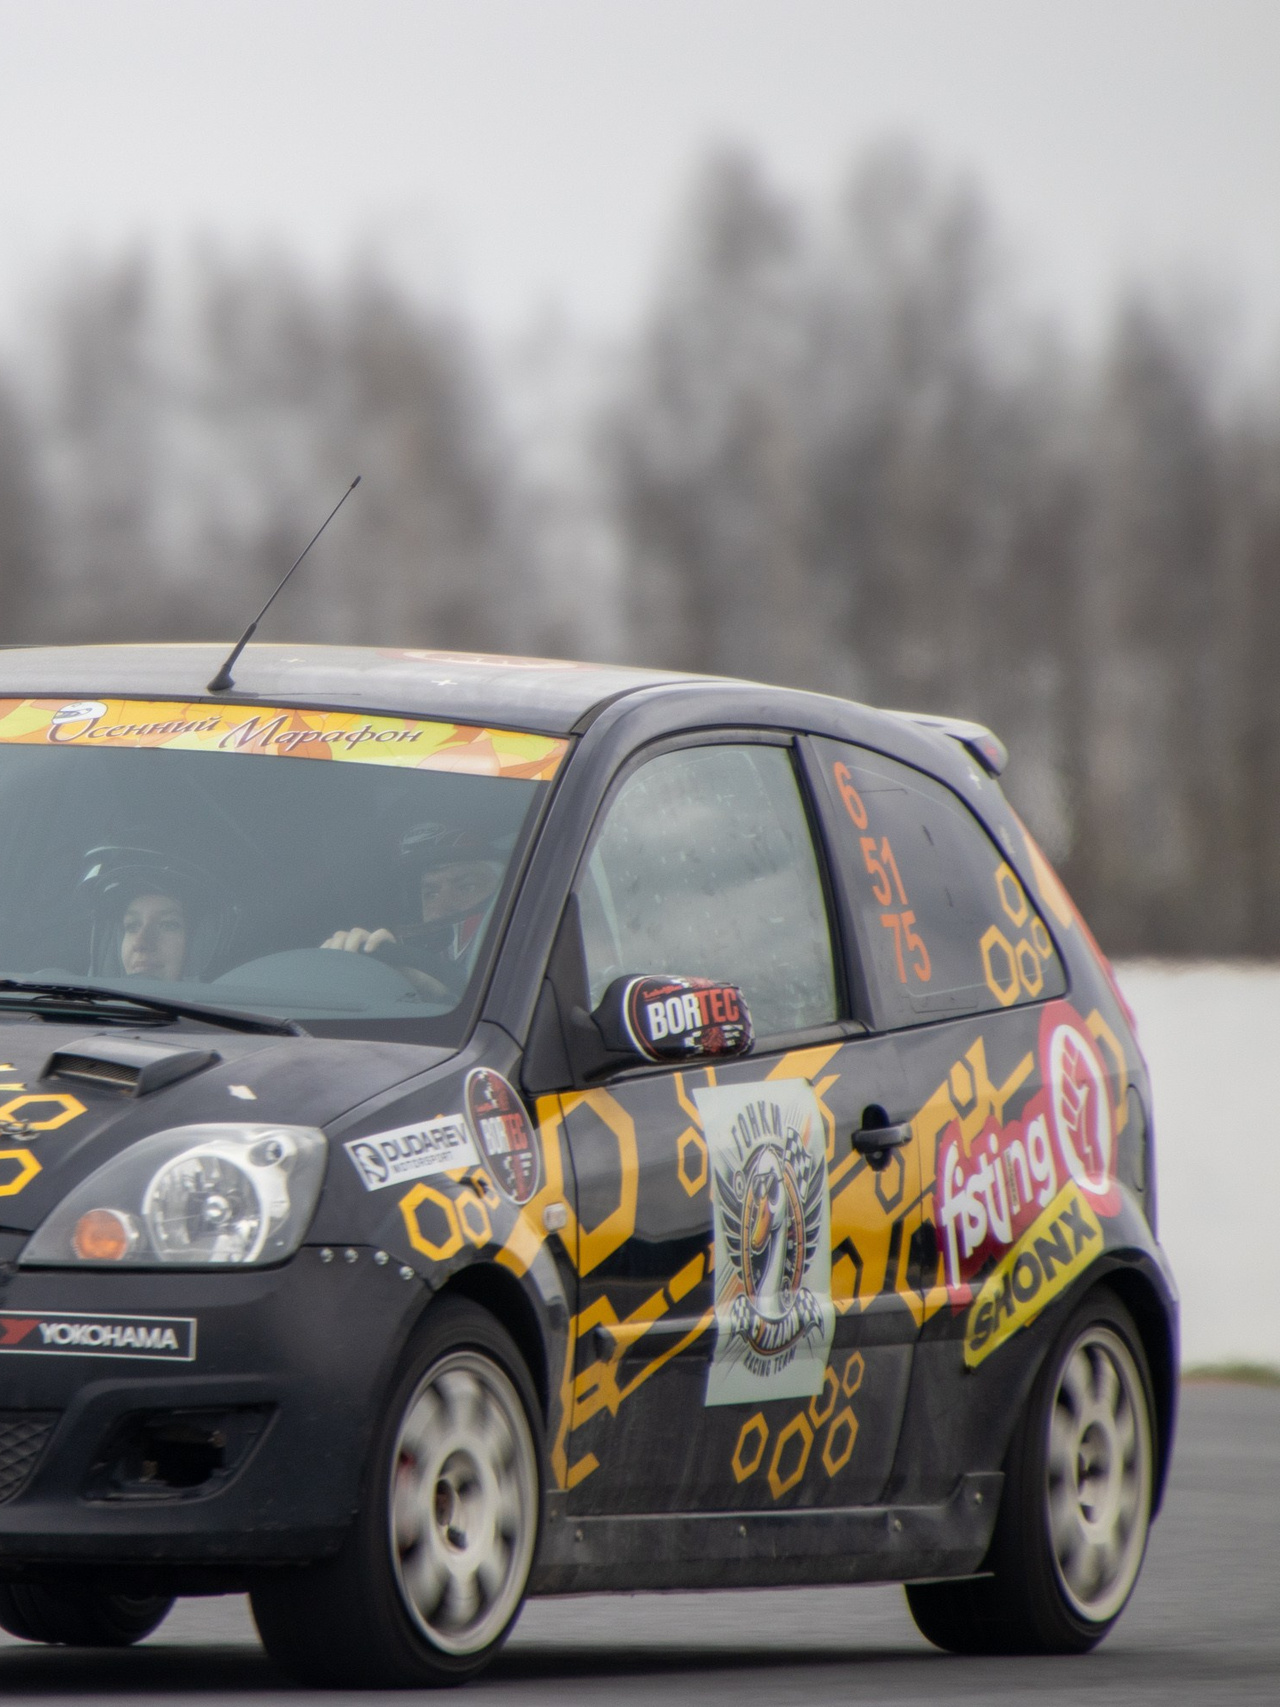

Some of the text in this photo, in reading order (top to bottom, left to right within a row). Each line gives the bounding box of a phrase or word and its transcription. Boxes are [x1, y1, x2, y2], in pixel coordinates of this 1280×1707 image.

[46, 714, 424, 752] Осенний Марафон
[833, 761, 868, 830] 6
[859, 836, 909, 906] 51
[880, 910, 931, 983] 75
[646, 987, 740, 1041] BORTEC
[379, 1122, 468, 1162] DUDAREV
[941, 1112, 1060, 1291] fisting
[38, 1322, 179, 1350] YOKOHAMA
